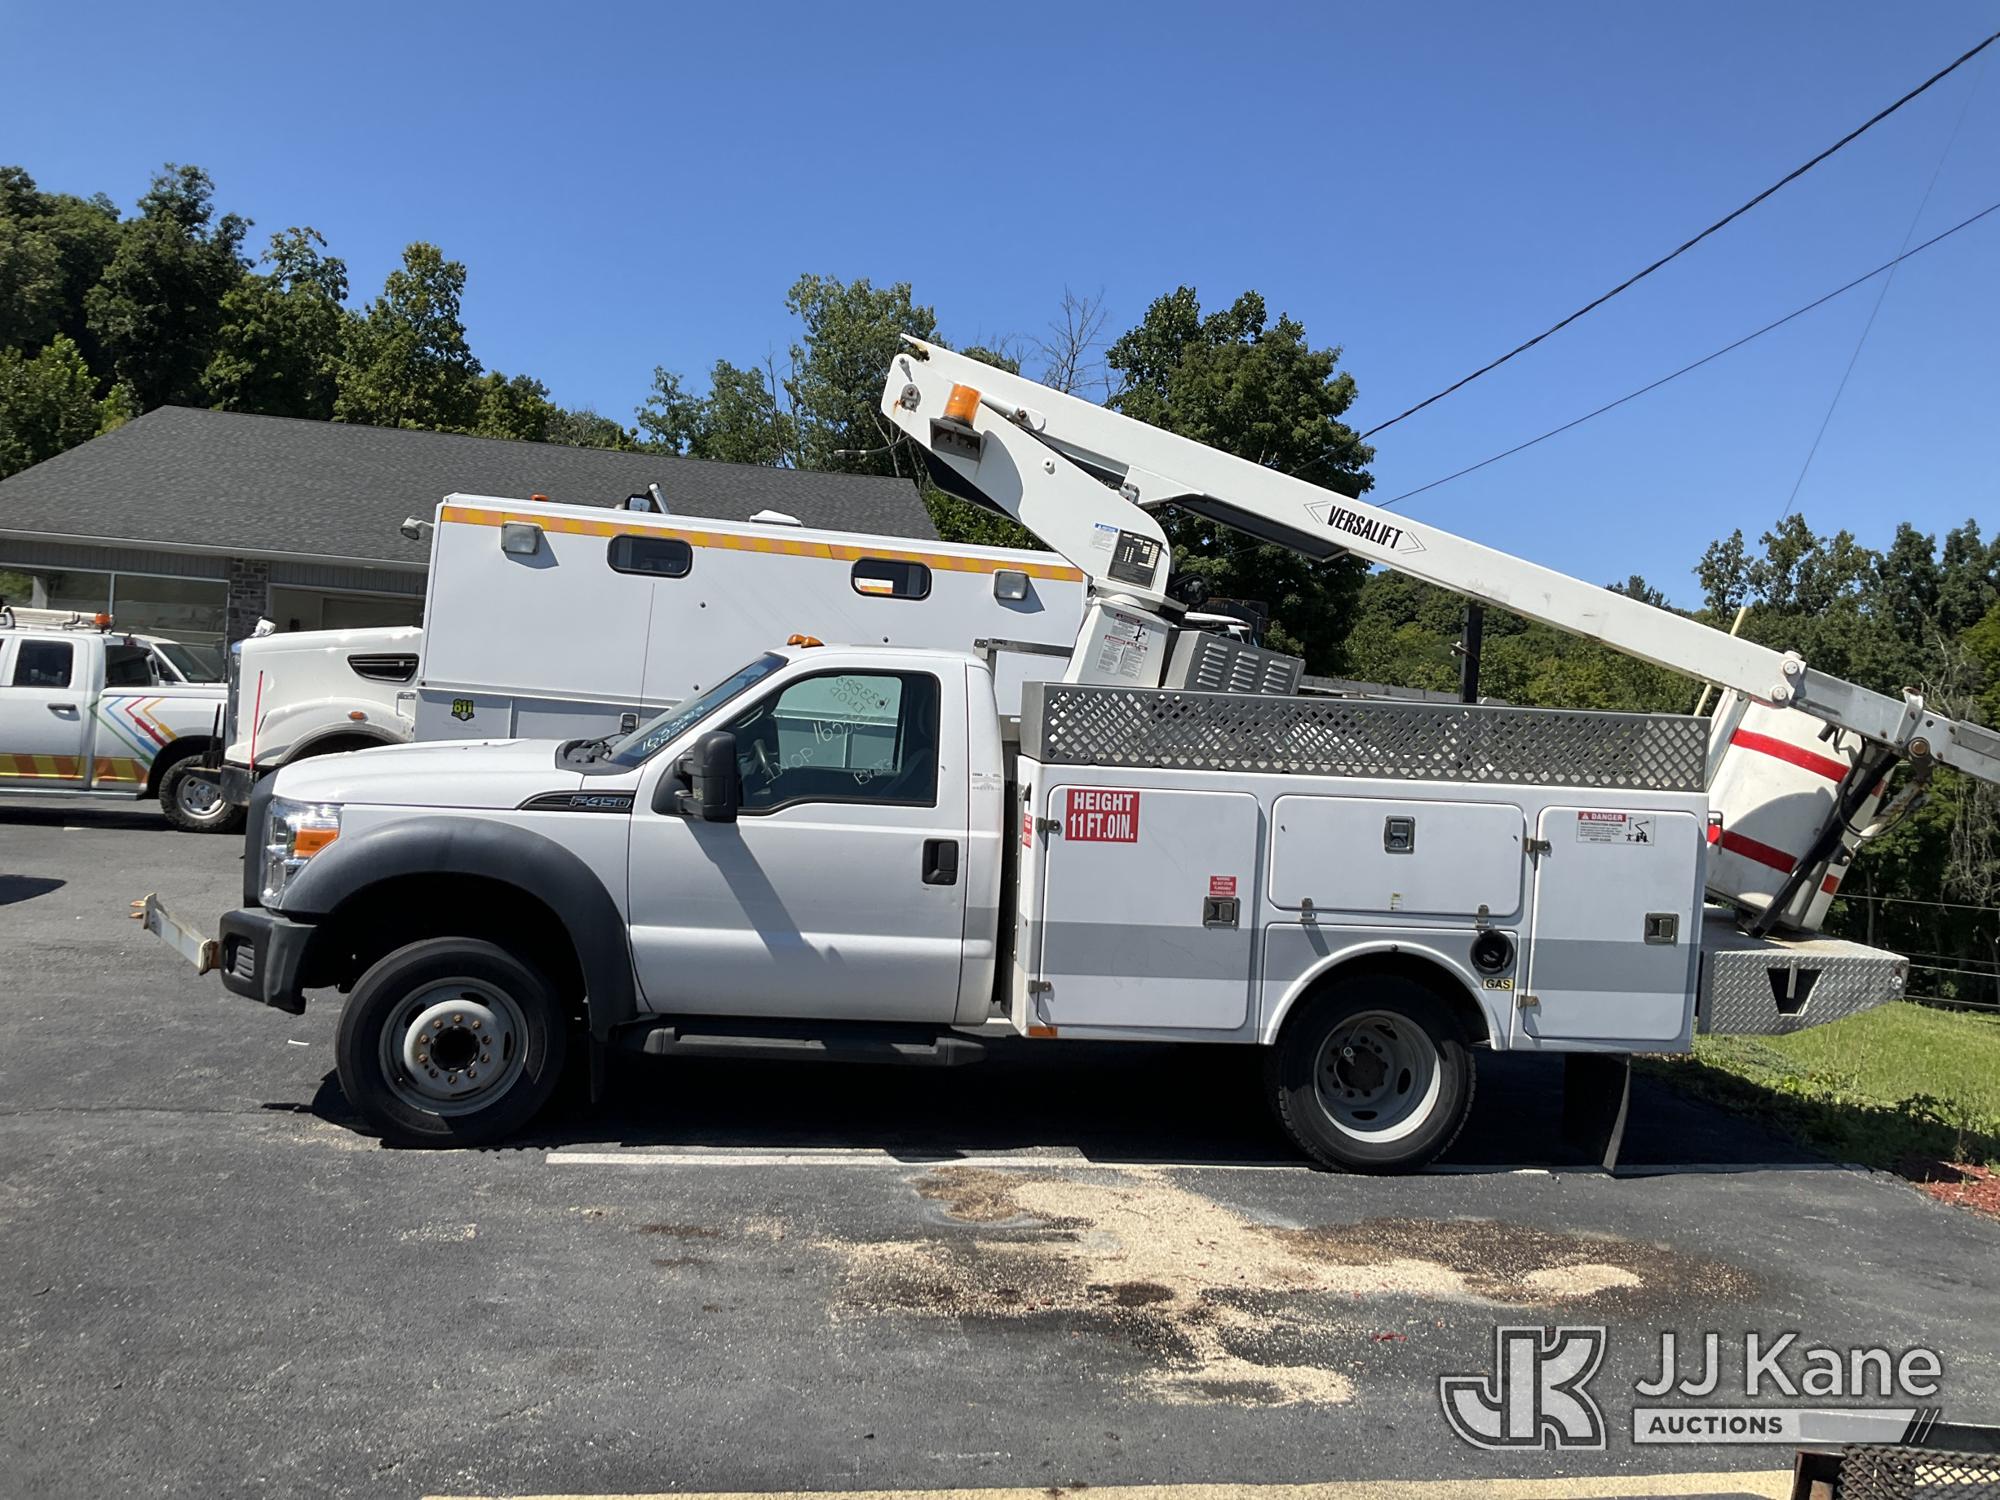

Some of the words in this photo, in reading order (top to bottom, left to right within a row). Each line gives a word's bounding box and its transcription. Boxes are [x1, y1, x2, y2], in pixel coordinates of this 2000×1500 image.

[1327, 505, 1403, 549] VERSALIFT
[1073, 792, 1134, 811] HEIGHT
[1591, 813, 1623, 821] DANGER
[1486, 978, 1511, 989] GAS
